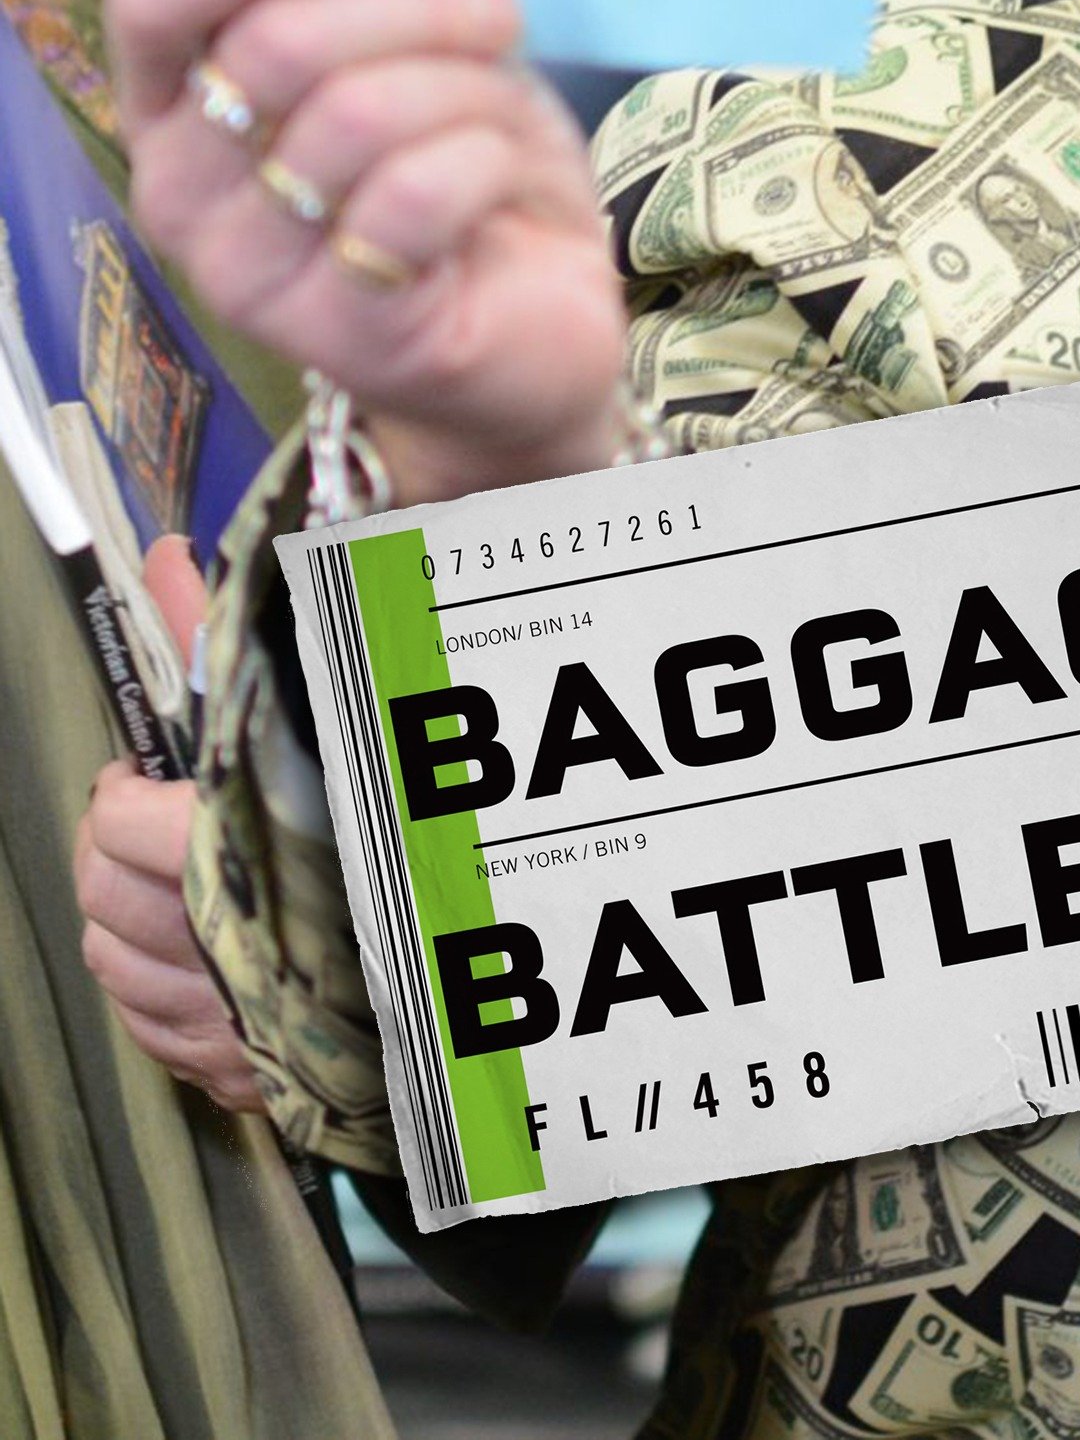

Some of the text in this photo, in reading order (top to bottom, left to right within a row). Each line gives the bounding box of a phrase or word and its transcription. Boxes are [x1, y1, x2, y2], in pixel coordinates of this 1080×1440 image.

[84, 583, 130, 683] Victorian
[116, 682, 154, 753] Casino
[790, 1327, 824, 1383] 20
